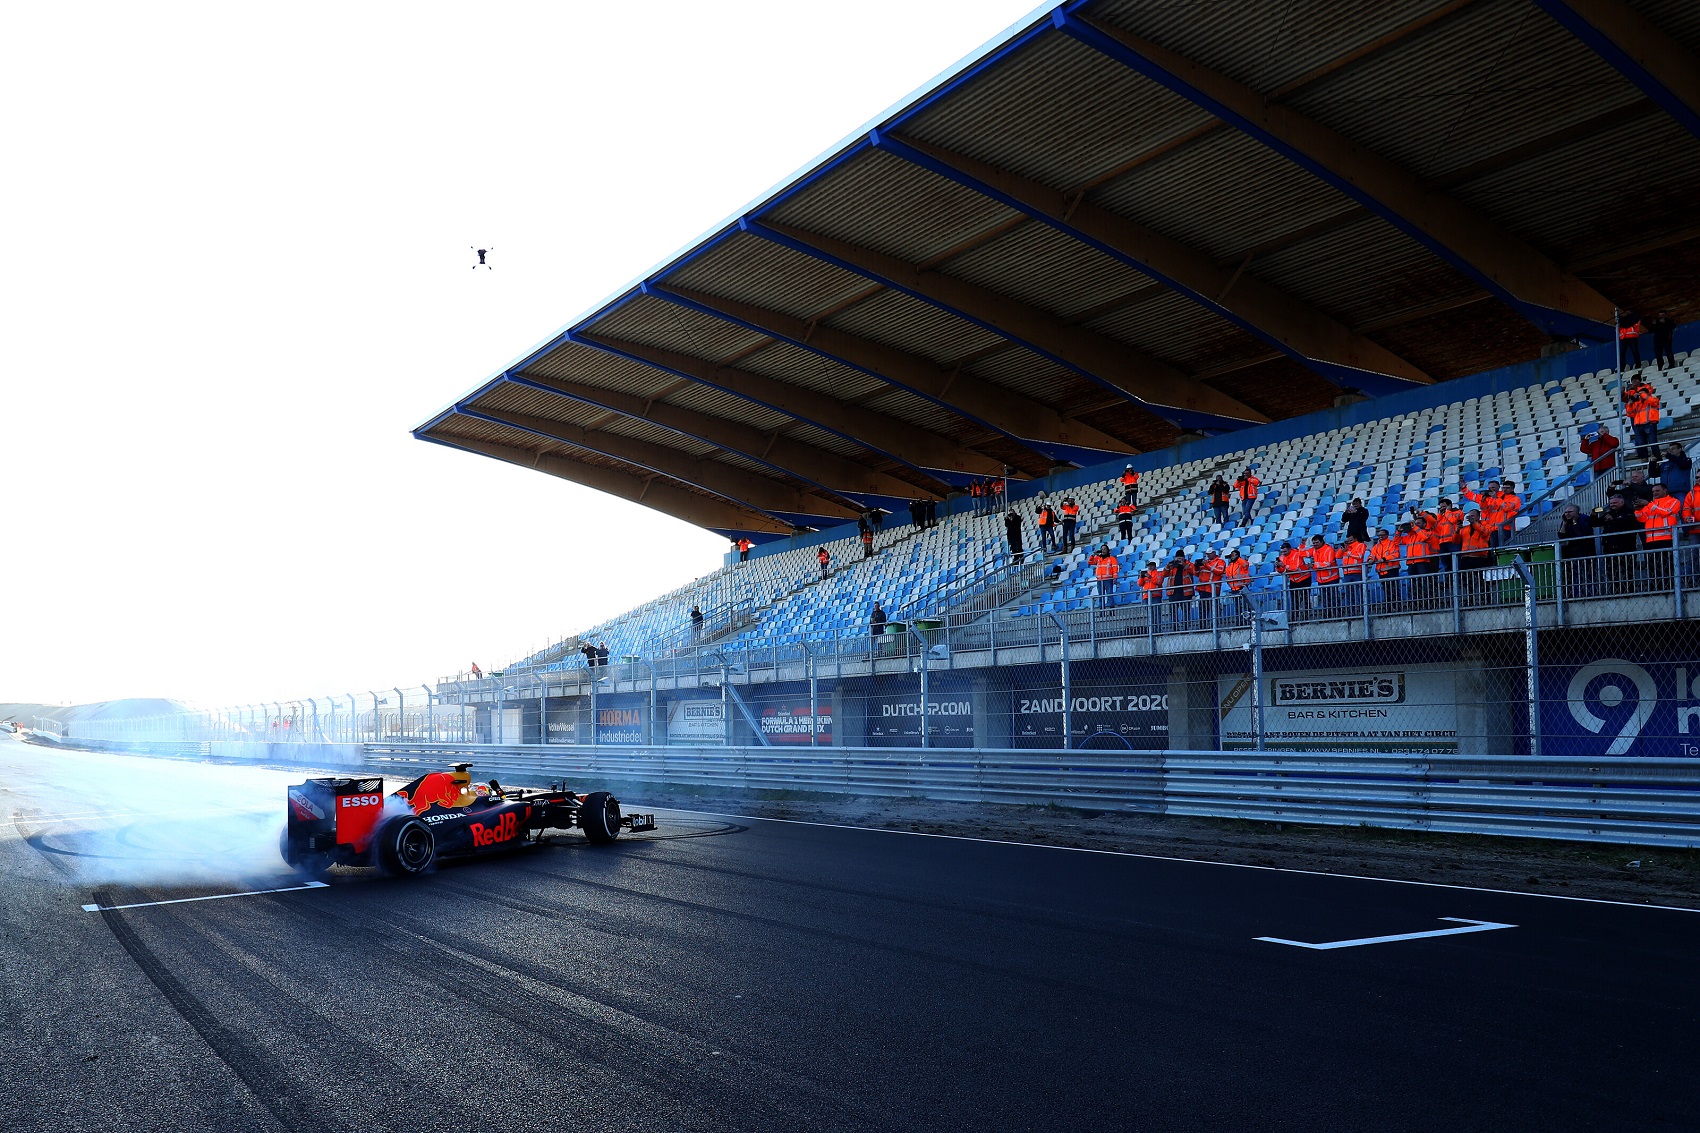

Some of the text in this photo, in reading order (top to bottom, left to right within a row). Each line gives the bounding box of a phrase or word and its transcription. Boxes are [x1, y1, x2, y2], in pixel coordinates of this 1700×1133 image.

[1279, 676, 1394, 701] BERNIE'S
[1288, 710, 1388, 719] BAR & KITCHEN
[761, 716, 794, 725] FORMULA
[761, 725, 825, 734] DUTCH GRAND PIX
[342, 795, 380, 808] ESSO
[422, 813, 467, 823] HONDA
